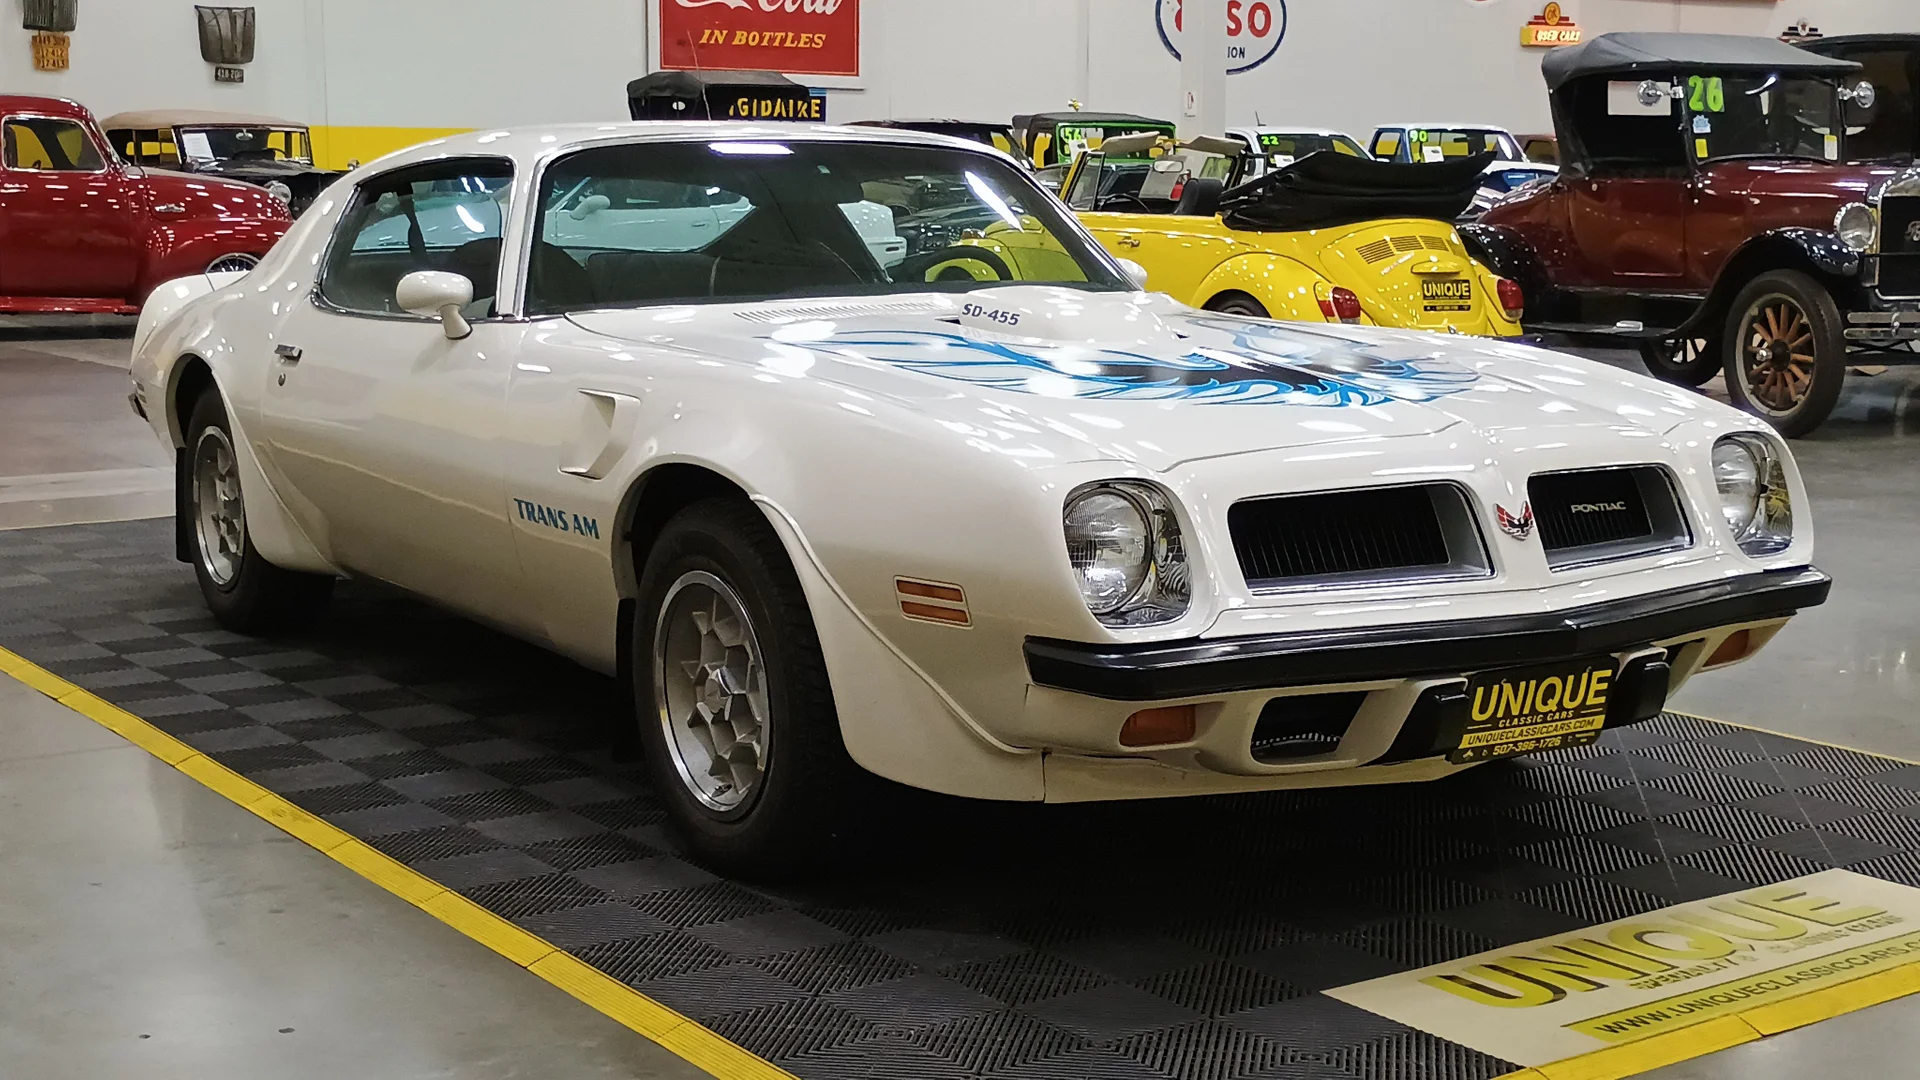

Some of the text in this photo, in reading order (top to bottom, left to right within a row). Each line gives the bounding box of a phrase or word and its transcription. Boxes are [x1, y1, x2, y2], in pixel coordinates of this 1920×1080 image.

[699, 29, 826, 48] IN BOTTLES
[1227, 46, 1245, 58] ION
[1688, 75, 1724, 112] 26
[1260, 136, 1279, 146] 22
[1409, 130, 1428, 143] 90
[1423, 282, 1470, 297] UNIQUE
[961, 303, 1020, 326] SD-455
[1570, 501, 1627, 514] PONTIAC
[513, 497, 600, 540] TRANS AM
[1471, 669, 1613, 722] UNIQUE
[1498, 709, 1575, 728] CLASSIC CARS
[1467, 717, 1596, 746] UNIQUECLASSICCARS.COM
[1418, 885, 1889, 1009] UNIQUE
[1594, 938, 1920, 1035] WWW.UNIQUECLASSICCARS.C
